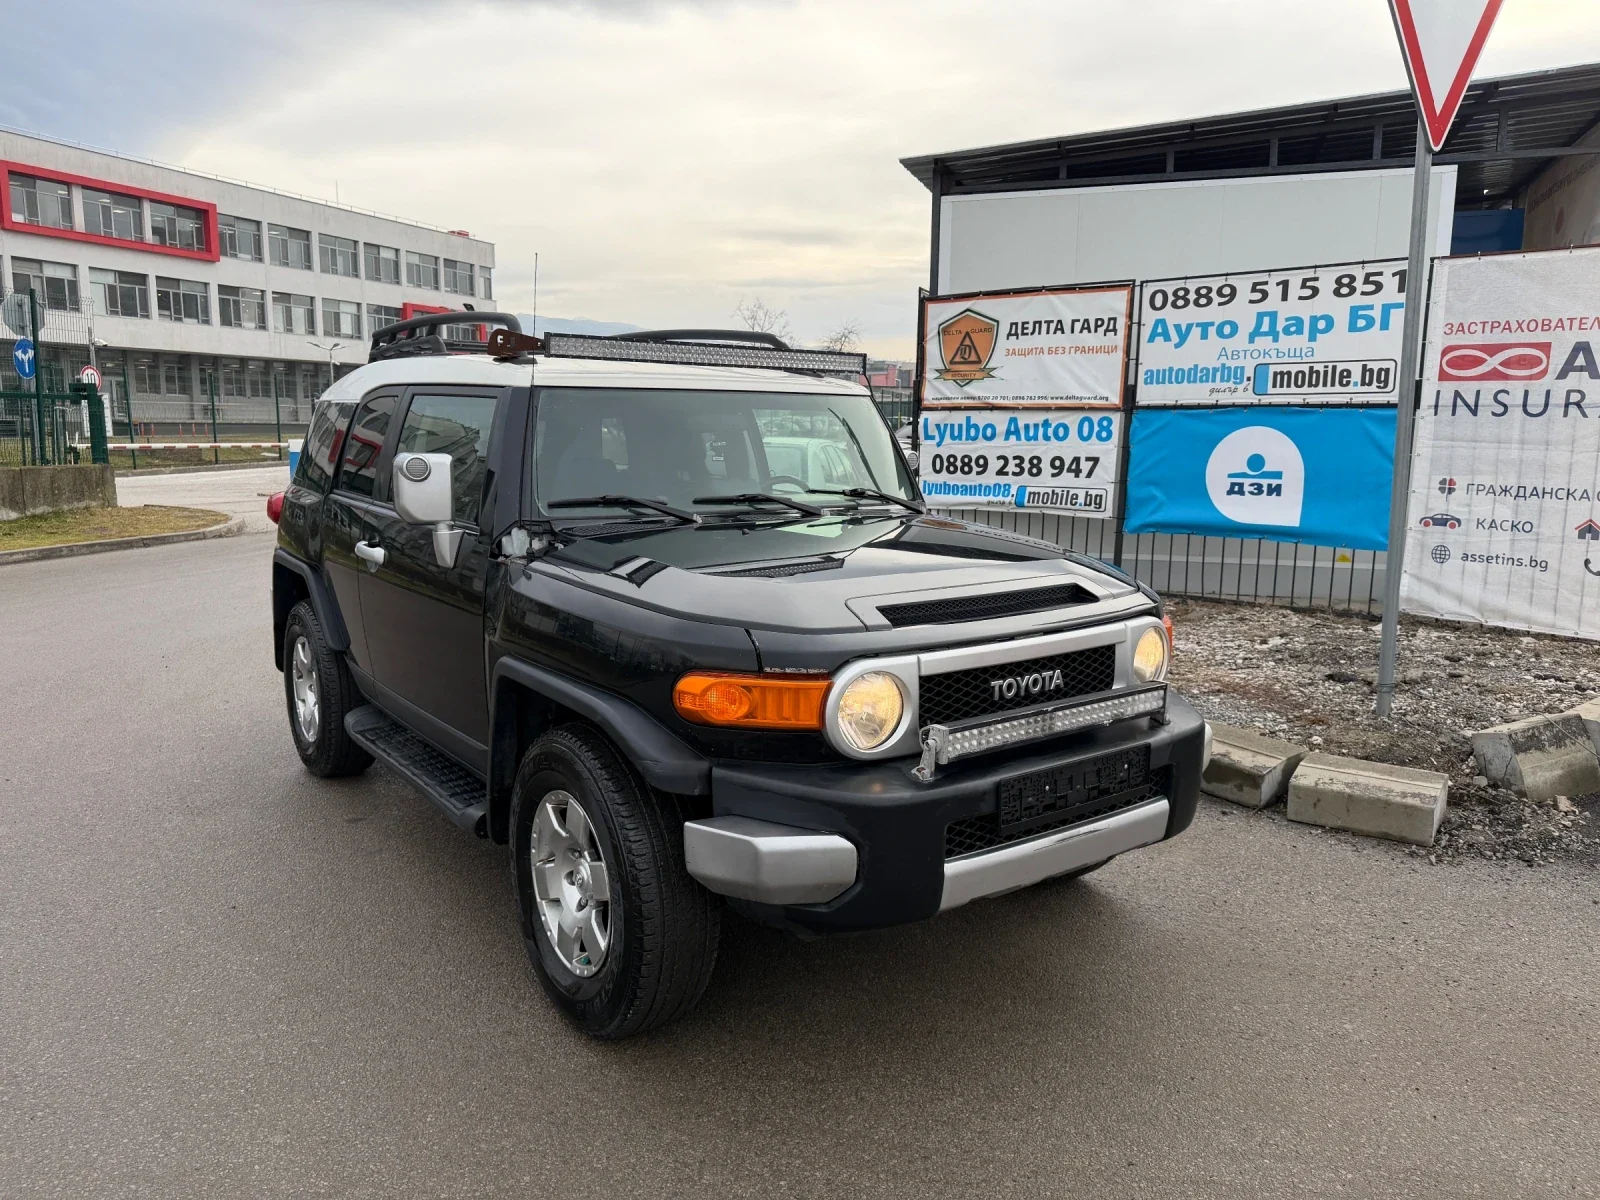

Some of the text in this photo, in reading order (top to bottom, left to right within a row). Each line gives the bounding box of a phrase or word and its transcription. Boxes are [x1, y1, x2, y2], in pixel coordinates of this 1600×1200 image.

[1148, 268, 1408, 311] 0889 515 851
[943, 327, 993, 337] DELTA GUARD
[1006, 316, 1118, 341] ДЕЛТА ГАРД
[1146, 302, 1405, 349] Ауто Дар БГ
[1443, 316, 1600, 336] ЗАСТРАХОВАТЕЛ
[1004, 344, 1118, 359] ЗАЩИТА БЕЗ ГРАНИЦИ
[1216, 346, 1315, 361] Автокъща
[1271, 364, 1391, 389] mobile.bg
[1433, 389, 1600, 419] INSUR
[922, 415, 1114, 448] Lyubo Auto 08
[931, 453, 1101, 479] 0889 238 947
[1026, 489, 1103, 510] mobile.bg
[1226, 481, 1283, 497] ДЗИ
[1465, 483, 1591, 502] ГРАЖДАНСКА
[1475, 517, 1534, 534] КАСКО
[1460, 551, 1549, 573] assetins.bg
[990, 669, 1065, 701] TOYOTA
